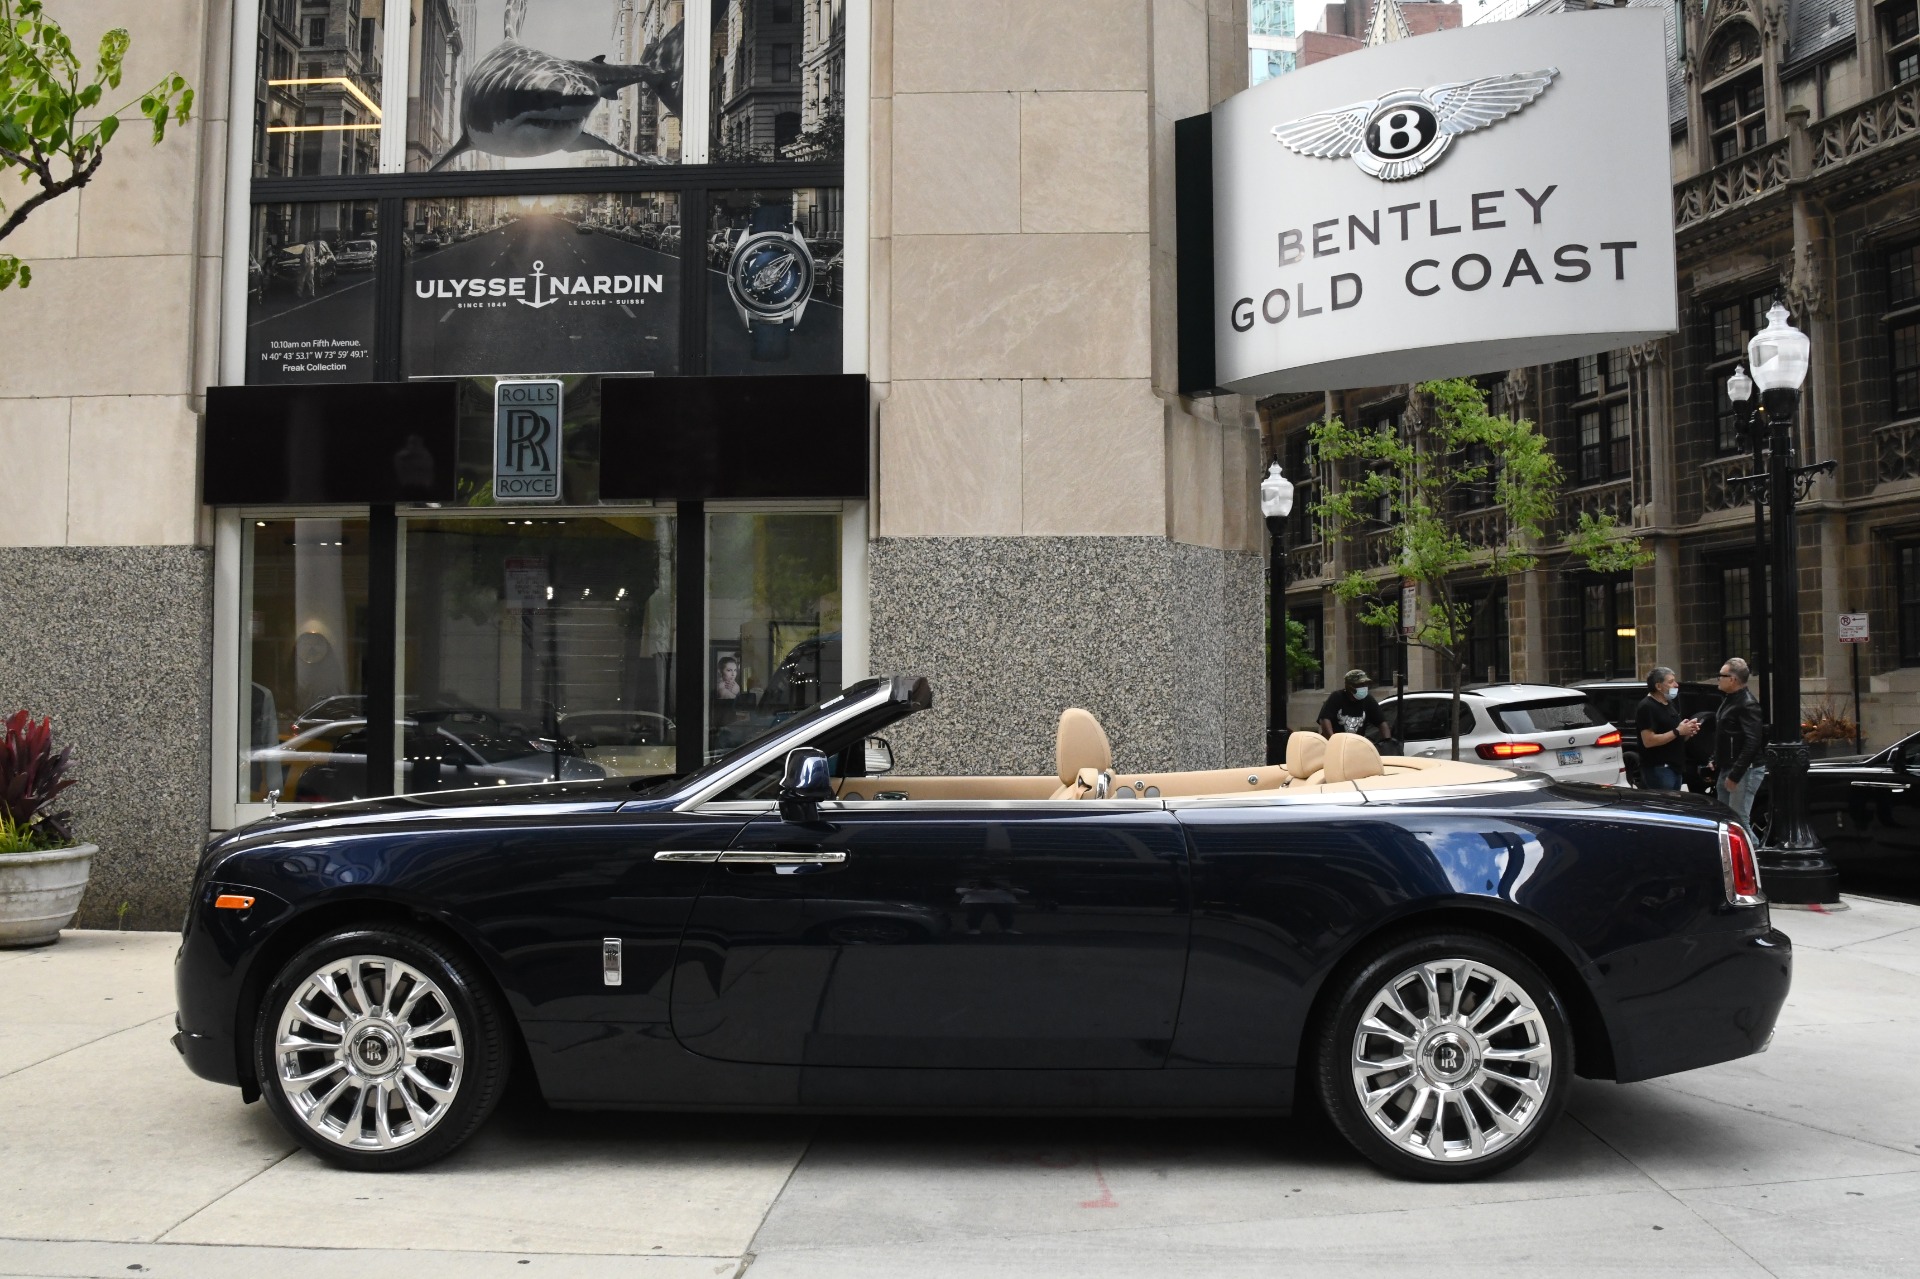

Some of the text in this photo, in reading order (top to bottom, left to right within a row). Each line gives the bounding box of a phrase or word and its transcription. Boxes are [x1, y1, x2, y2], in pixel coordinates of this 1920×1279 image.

[1377, 108, 1423, 155] B
[1278, 184, 1559, 268] BENTLEY
[415, 274, 663, 299] ULYSSE NARDIN
[1231, 241, 1638, 333] GOLD COAST
[270, 340, 299, 349] 10.10am
[313, 339, 329, 347] Fifth
[331, 339, 361, 347] Avenue.
[314, 351, 323, 359] W
[324, 351, 336, 359] 73°
[282, 362, 347, 372] Freak Collection
[502, 388, 554, 401] ROLLS
[500, 479, 552, 493] ROYCE
